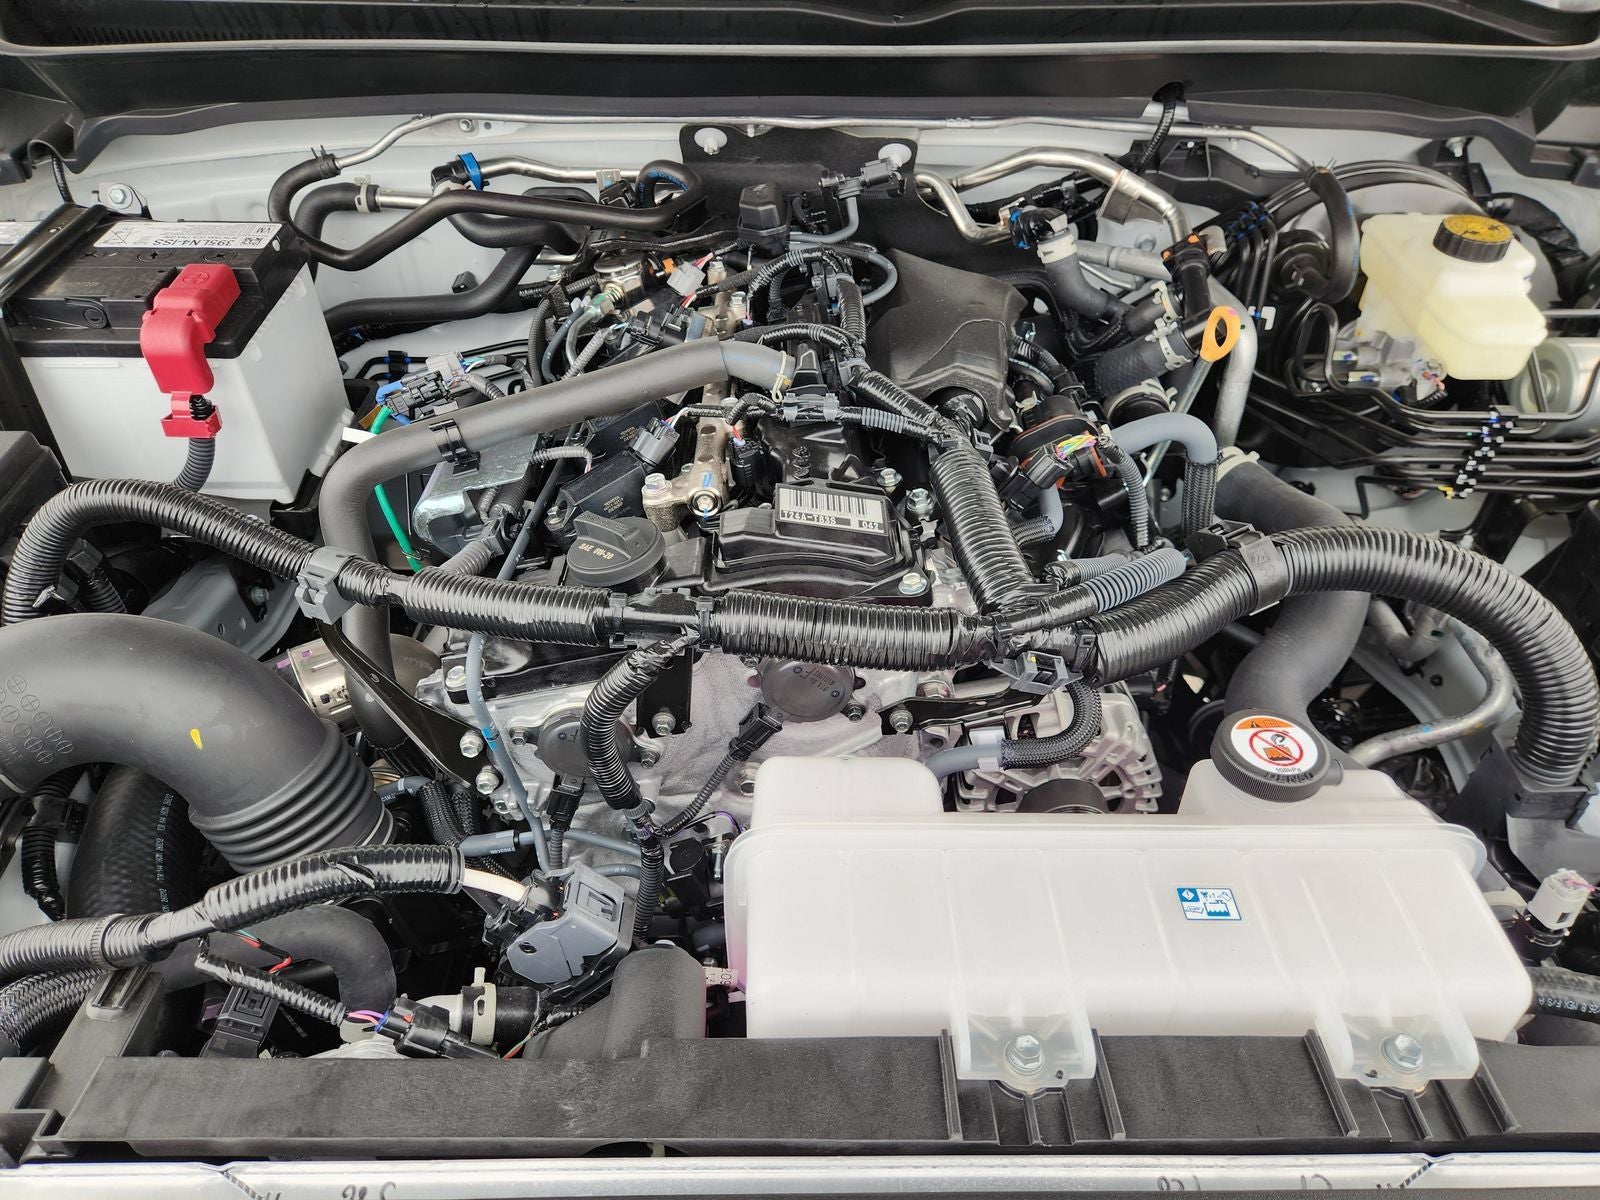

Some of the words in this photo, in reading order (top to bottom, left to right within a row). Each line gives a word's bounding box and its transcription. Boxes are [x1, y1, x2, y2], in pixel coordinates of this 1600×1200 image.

[862, 521, 879, 530] 042
[579, 543, 594, 552] SAE
[593, 548, 614, 560] 0W-20
[1265, 772, 1314, 783] DENSO
